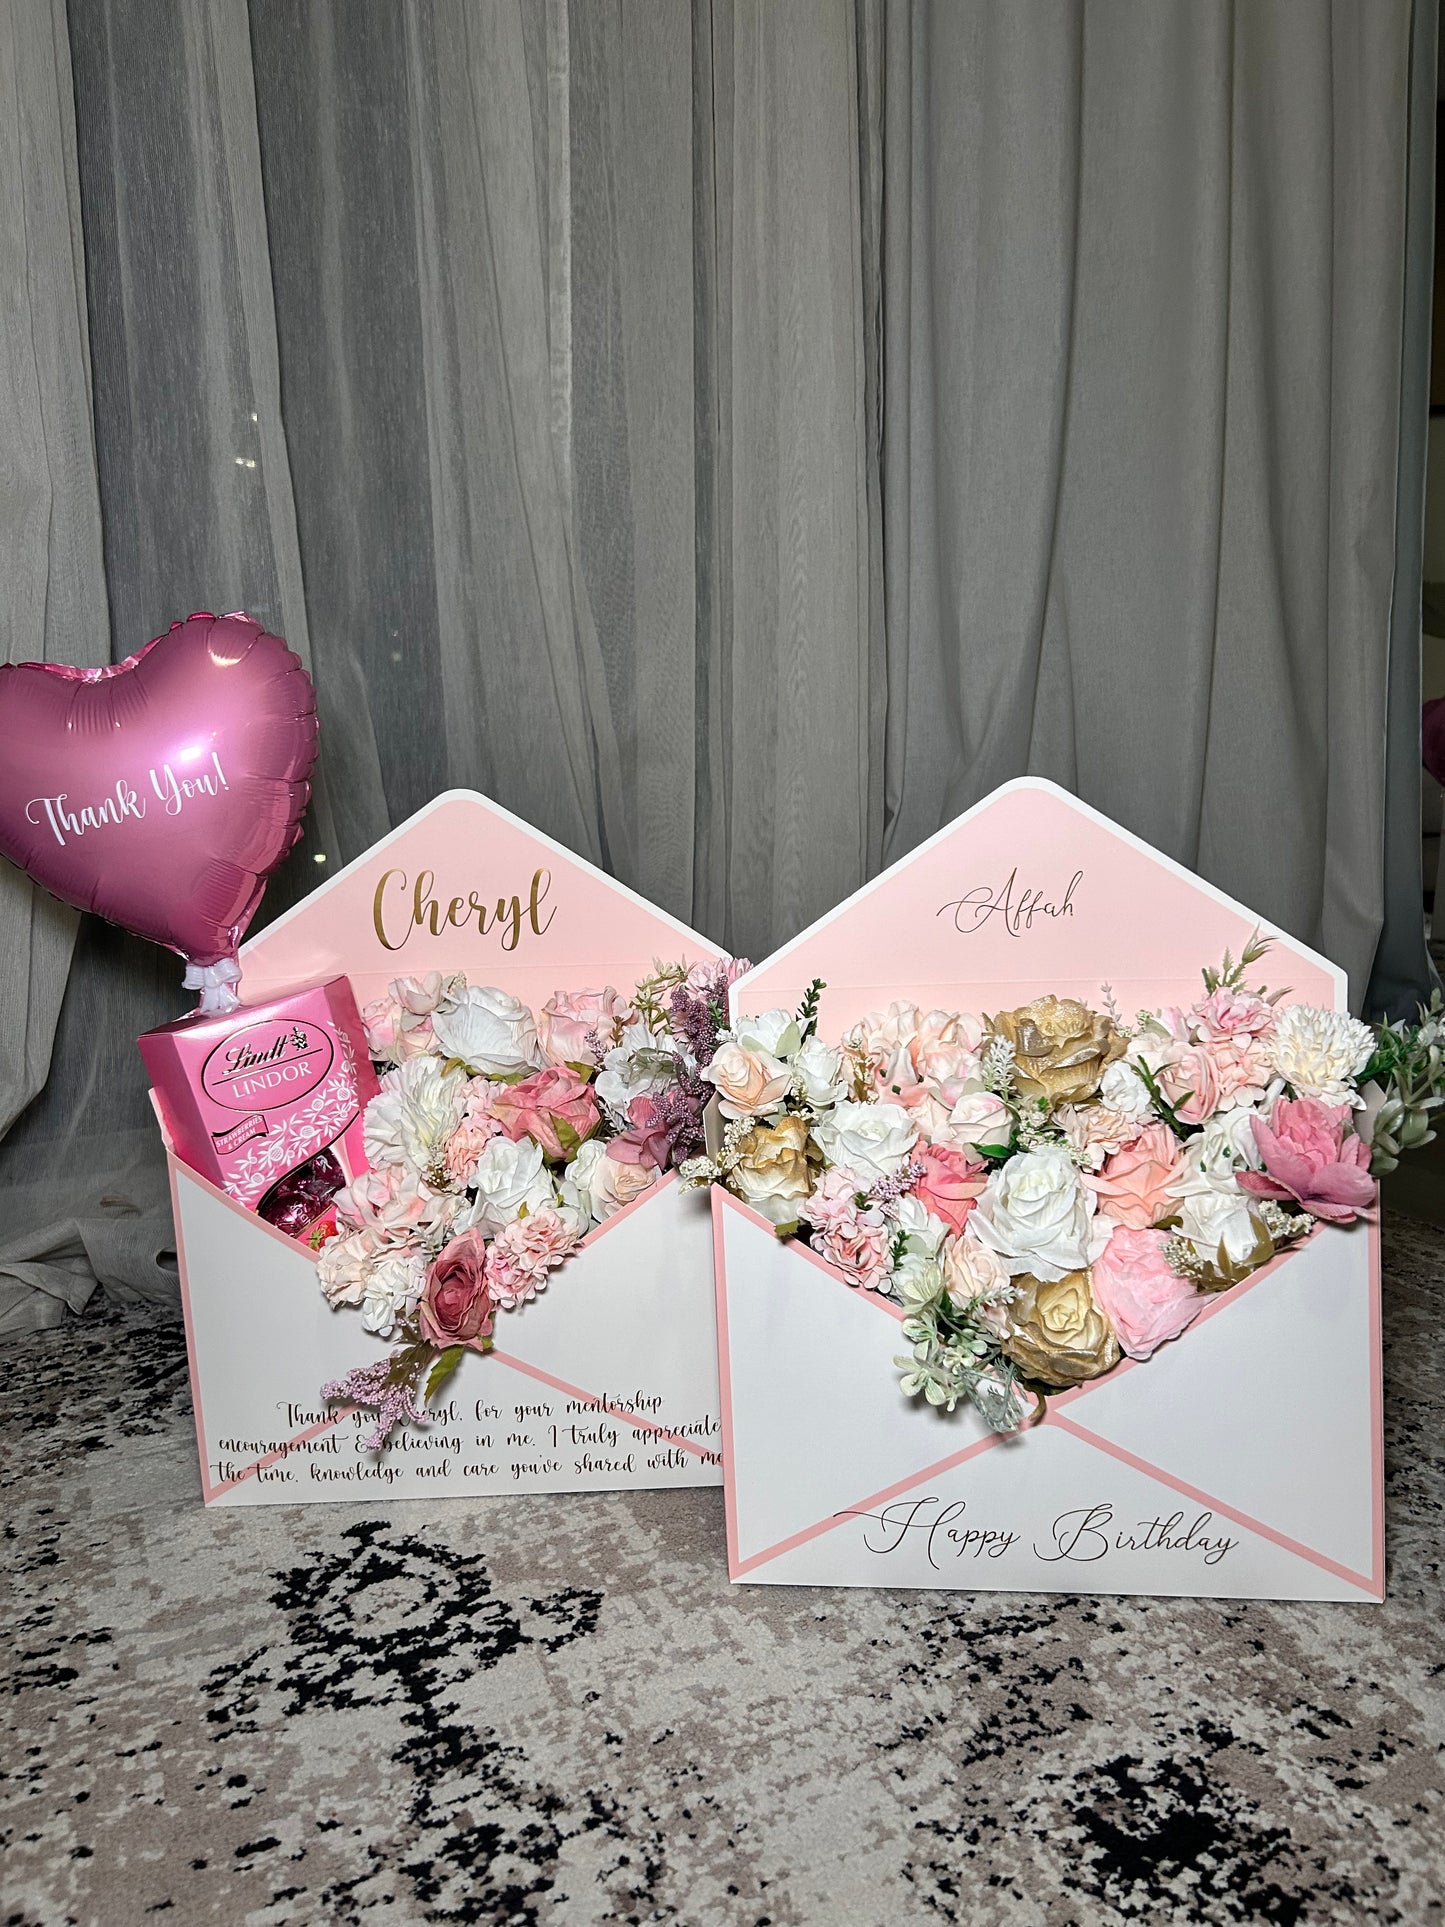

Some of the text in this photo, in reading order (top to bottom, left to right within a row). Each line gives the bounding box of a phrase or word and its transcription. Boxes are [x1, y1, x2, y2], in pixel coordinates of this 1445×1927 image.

[26, 752, 230, 846] Thank You!
[373, 868, 557, 951] Cheryl
[936, 867, 1083, 937] Affah
[222, 1034, 291, 1075] Lindt
[233, 1062, 312, 1098] LINDOR
[216, 1115, 263, 1147] STRAWBERRIES
[233, 1128, 256, 1146] CREAM
[276, 1402, 345, 1428] Thank
[351, 1411, 381, 1428] you
[474, 1399, 503, 1421] for
[514, 1401, 555, 1423] your
[566, 1390, 664, 1415] mentorship
[219, 1434, 349, 1458] encouragement
[354, 1435, 368, 1453] &
[382, 1432, 464, 1453] believing
[476, 1435, 495, 1447] in
[547, 1424, 557, 1447] I
[561, 1423, 620, 1447] truly
[632, 1414, 722, 1444] appreciate
[209, 1461, 246, 1482] the
[310, 1463, 404, 1484] knowledge
[415, 1459, 452, 1478] and
[463, 1463, 499, 1476] care
[511, 1454, 562, 1479] you've
[574, 1453, 637, 1475] shared
[647, 1448, 689, 1470] with
[833, 1496, 1240, 1571] Happy Birthday
